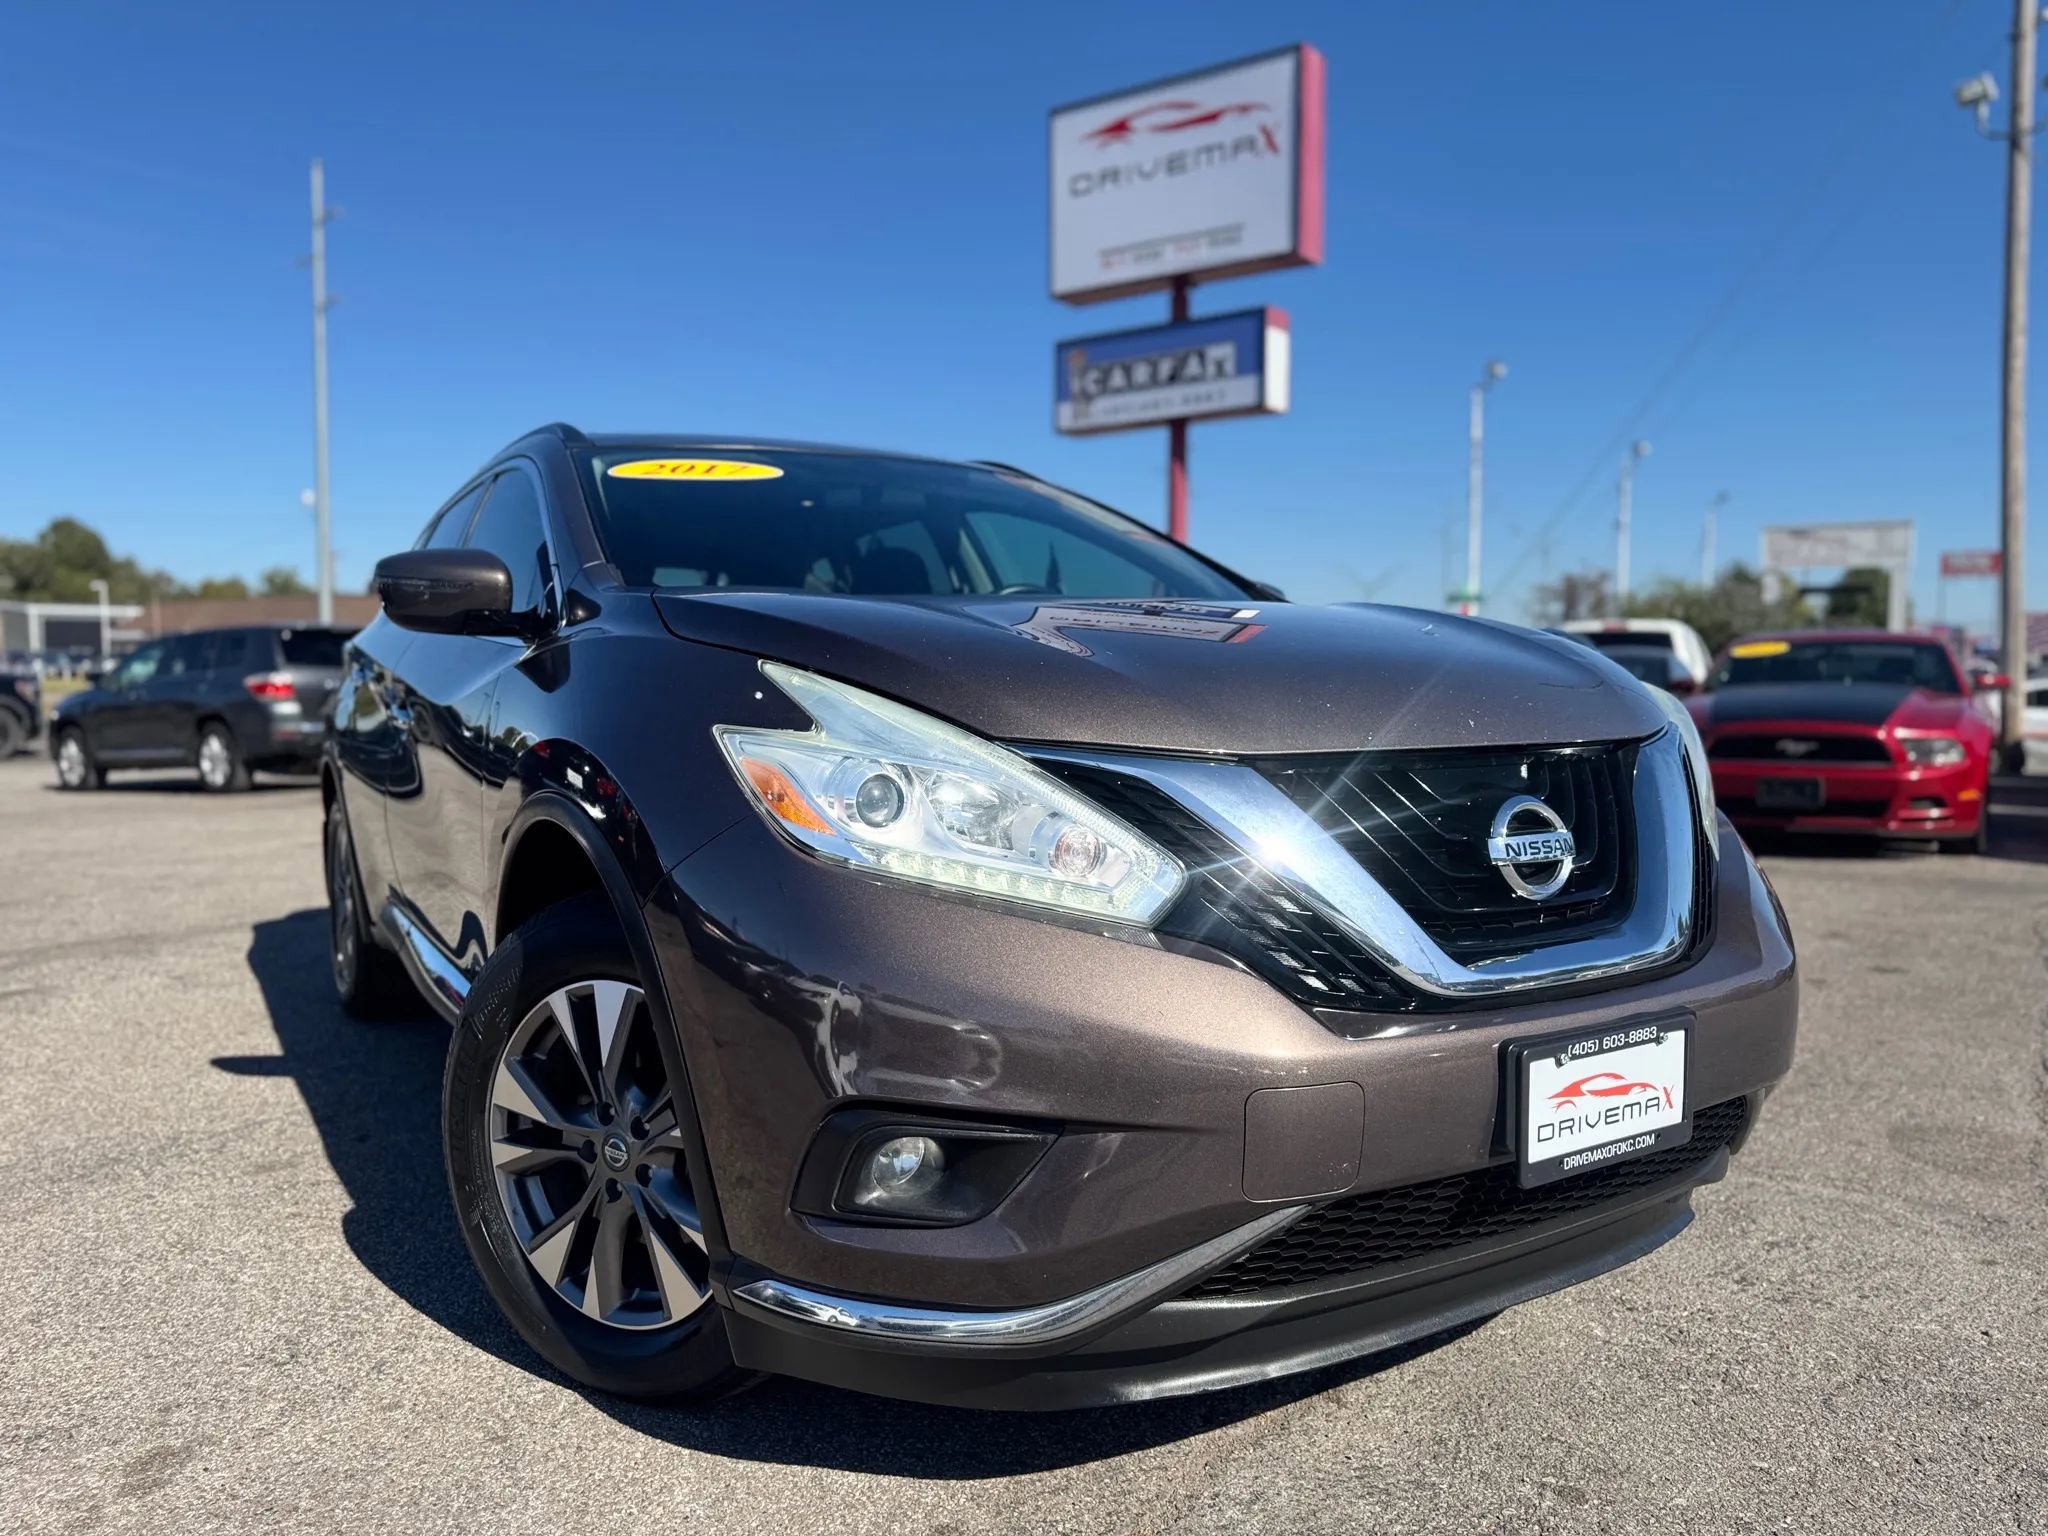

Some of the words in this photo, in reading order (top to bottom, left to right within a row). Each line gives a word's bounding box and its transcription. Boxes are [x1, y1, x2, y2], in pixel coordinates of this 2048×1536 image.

[1068, 121, 1280, 198] DRIVEMAX
[641, 463, 751, 475] 2017
[1504, 837, 1573, 858] NISSAN
[1567, 1039, 1600, 1058] (405)
[1602, 1026, 1657, 1050] 603-8883
[1537, 1084, 1675, 1143] DRIVEMAX
[1563, 1133, 1656, 1170] DRIVEMAXOFOKC.COM
